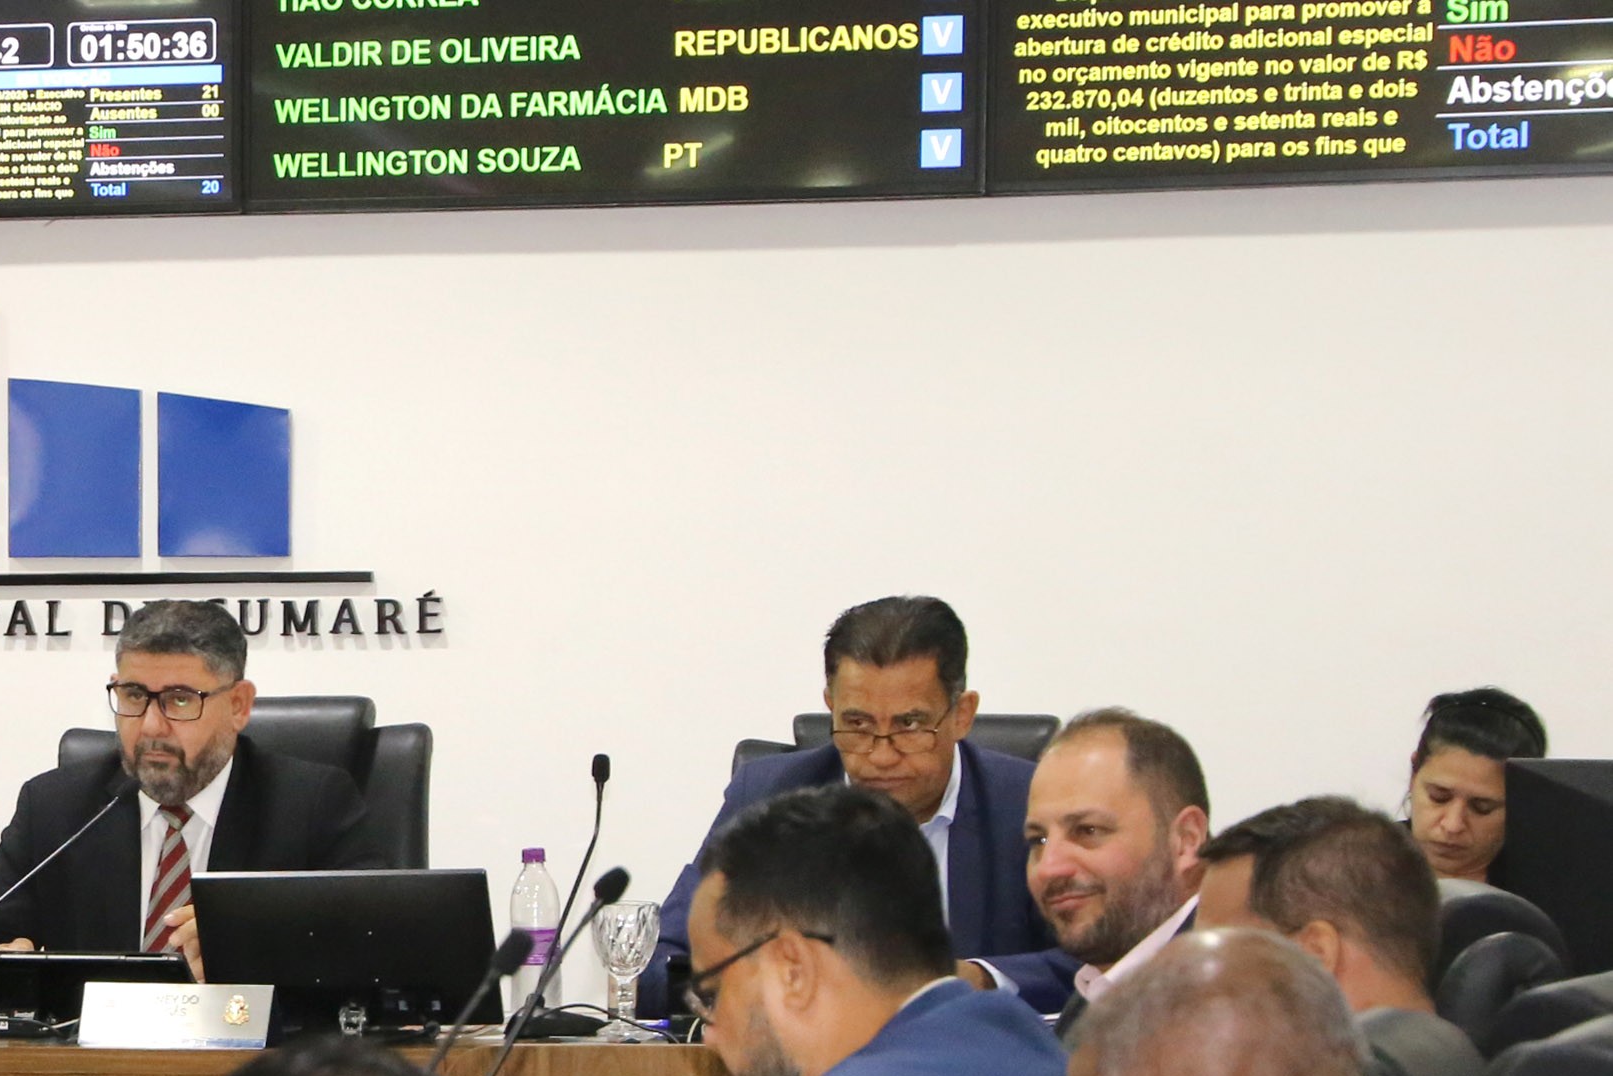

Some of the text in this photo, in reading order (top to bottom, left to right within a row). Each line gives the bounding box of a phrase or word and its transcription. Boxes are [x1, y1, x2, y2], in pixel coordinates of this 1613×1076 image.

[1017, 8, 1123, 29] executivo
[1129, 3, 1238, 27] municipal
[1245, 5, 1295, 26] para
[1302, 0, 1412, 24] promover
[1447, 0, 1508, 23] Sim
[81, 31, 207, 61] 01:50:36
[675, 23, 918, 56] REPUBLICANOS
[932, 22, 954, 47] V
[1014, 22, 1433, 56] abertura de crédito adicional especial
[276, 35, 580, 68] VALDIR DE OLIVEIRA
[1450, 35, 1516, 63] Não
[1019, 49, 1427, 85] no orçamento vigente no valor de R$
[90, 85, 218, 102] Presentes 21
[275, 84, 667, 123] WELINGTON DA FARMÁCIA
[680, 86, 748, 112] MDB
[931, 79, 953, 104] V
[1026, 78, 1418, 111] 232.870,04 (duzentos e trinta e dois
[90, 104, 220, 121] Ausentes 00
[1046, 107, 1398, 139] mil, oitocentos e setenta reais e
[89, 125, 117, 139] Sim
[1448, 121, 1529, 150] Total
[90, 142, 120, 157] Não
[664, 143, 702, 168] PT
[930, 135, 952, 160] V
[1036, 136, 1406, 168] quatro centavos) para os fins que
[90, 160, 175, 177] Abstenções
[274, 146, 581, 178] WELLINGTON SOUZA
[91, 180, 219, 196] Total 20
[206, 590, 443, 635] UMARÉ
